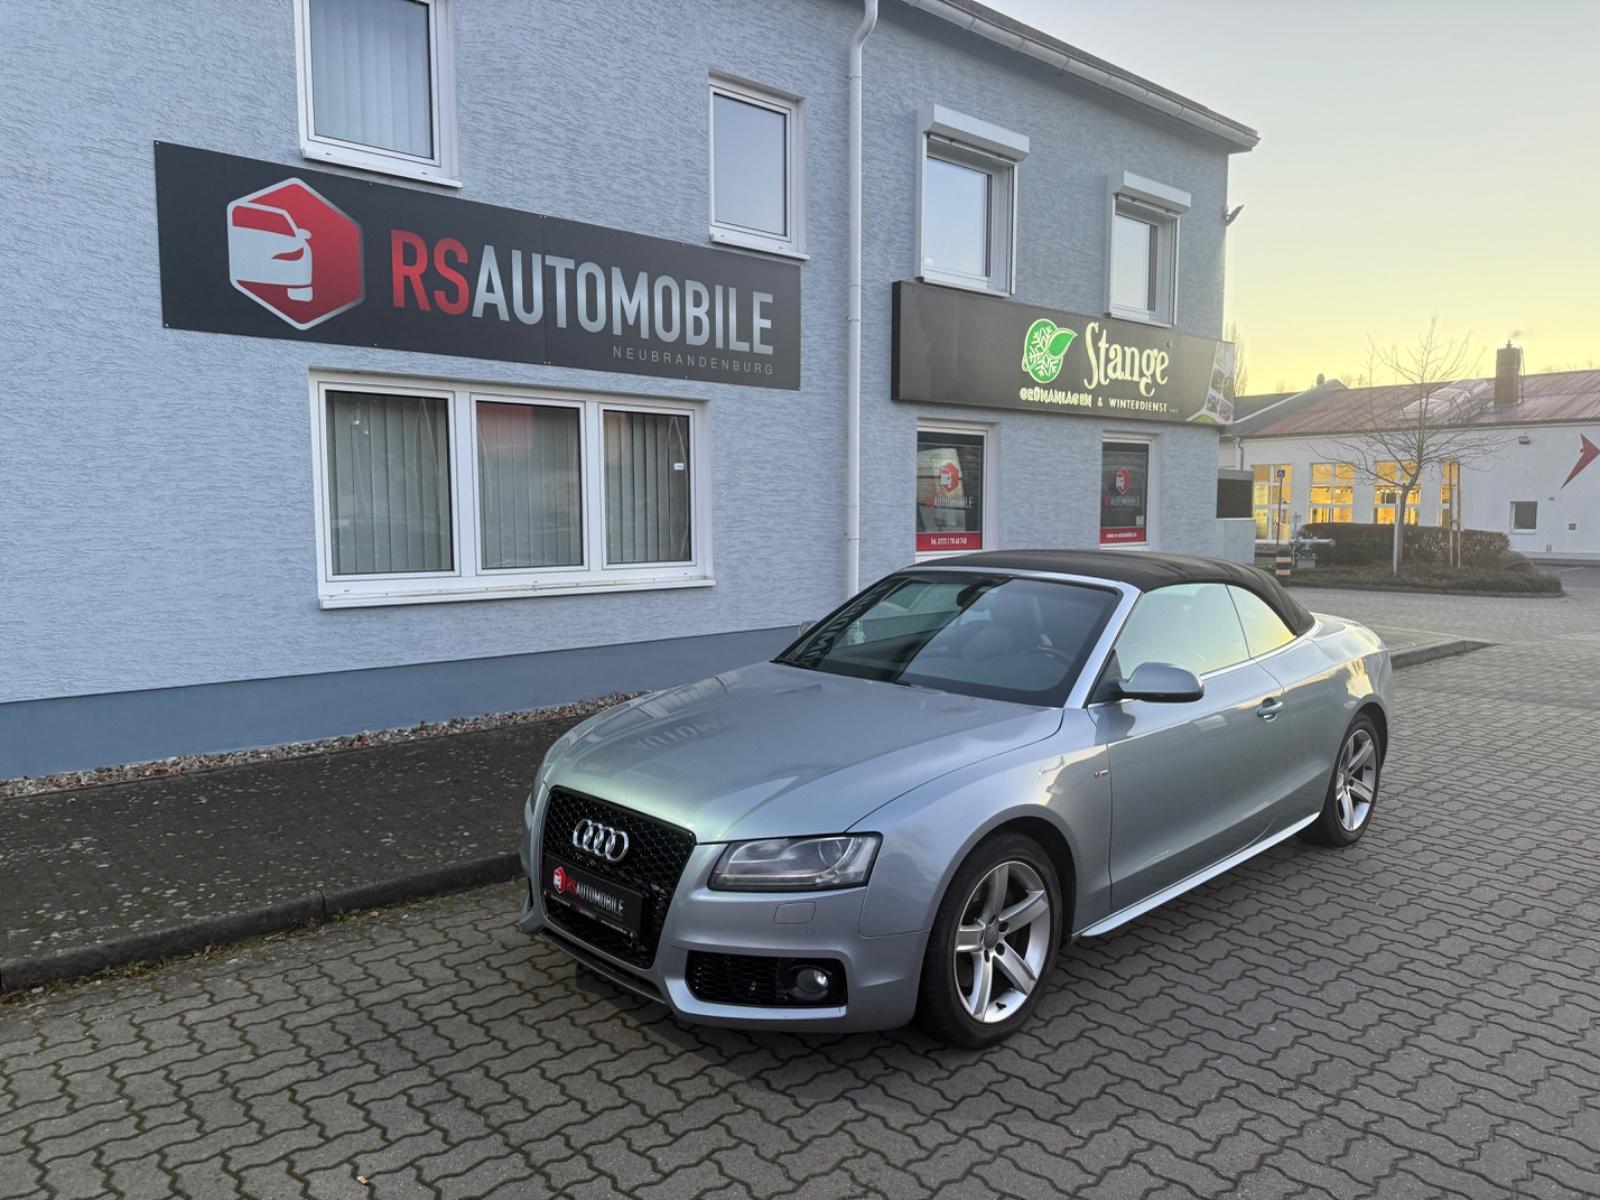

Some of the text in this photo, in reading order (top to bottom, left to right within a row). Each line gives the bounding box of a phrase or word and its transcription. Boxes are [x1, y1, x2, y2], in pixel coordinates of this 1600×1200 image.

[613, 346, 773, 375] NEUBRANDENBURG
[1083, 322, 1169, 397] Stange
[1097, 397, 1103, 407] &
[1109, 397, 1168, 413] WINTERDIENST
